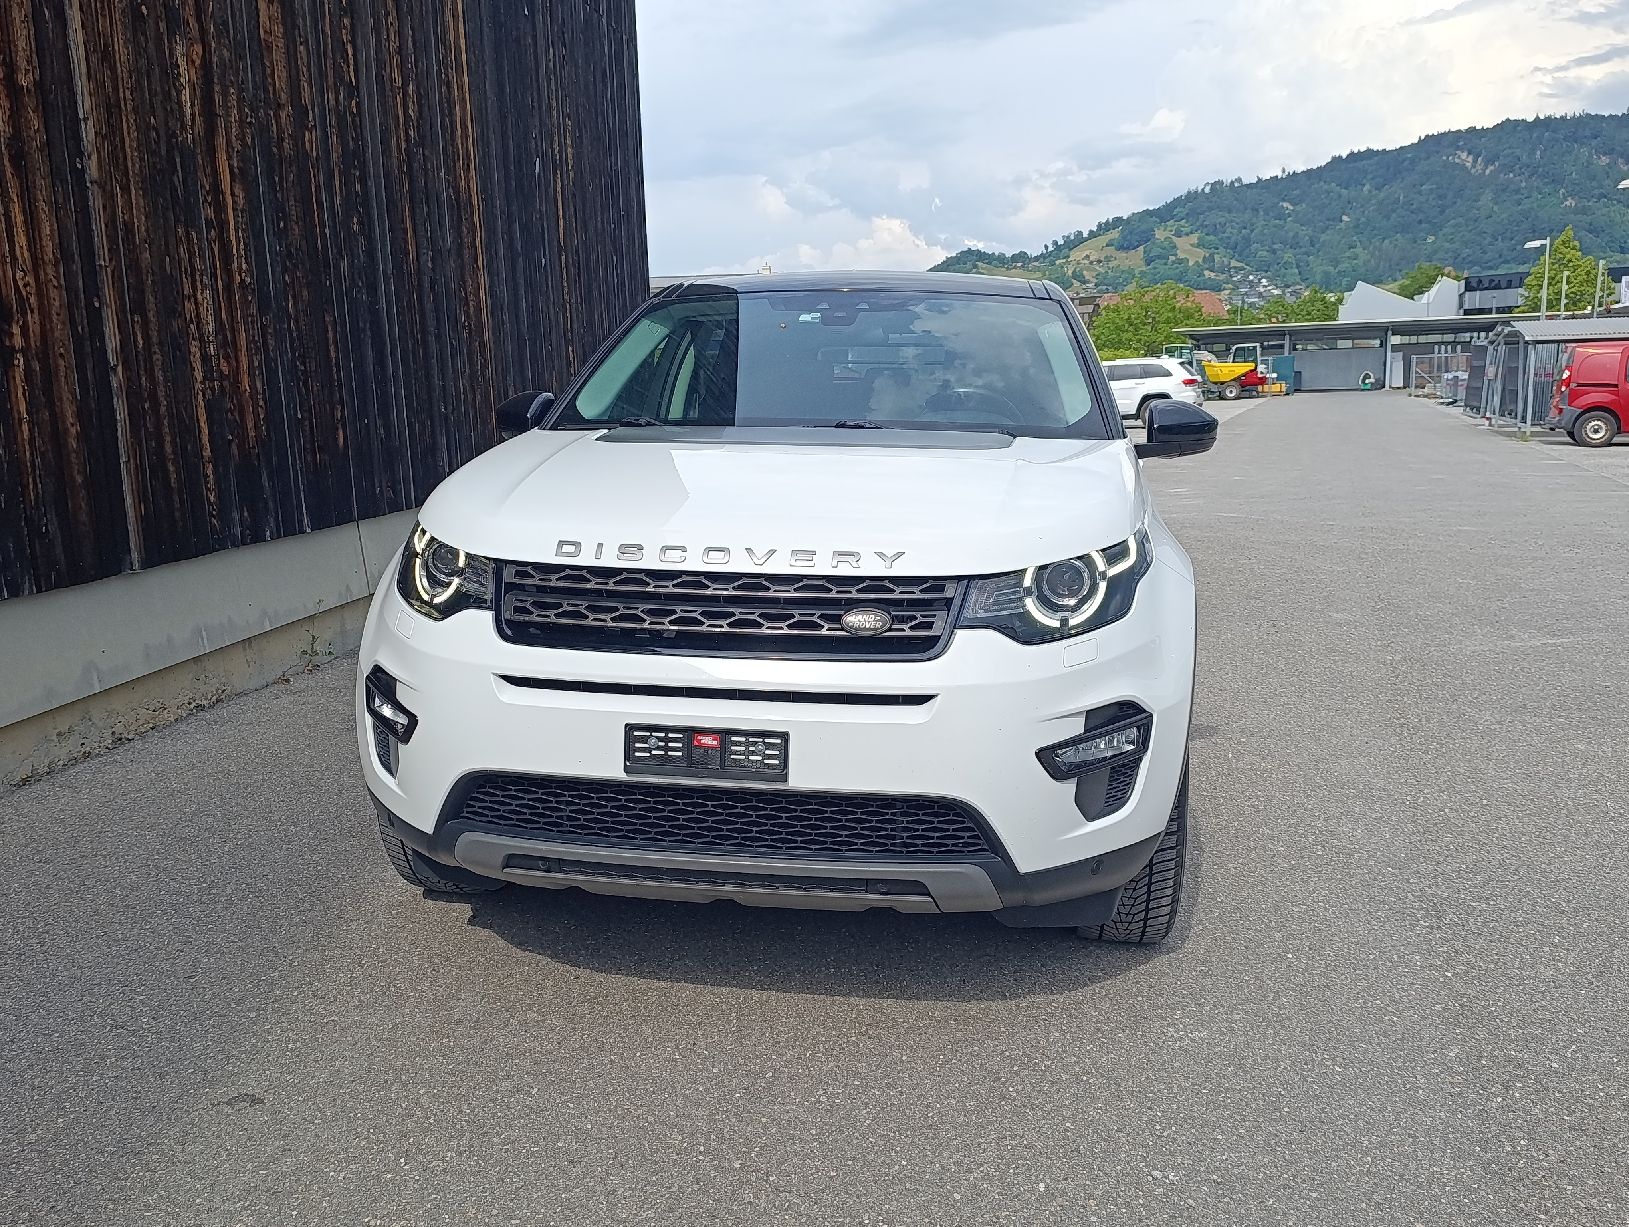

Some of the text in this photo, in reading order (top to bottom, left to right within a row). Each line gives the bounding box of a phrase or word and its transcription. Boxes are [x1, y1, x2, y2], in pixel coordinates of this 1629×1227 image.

[555, 540, 905, 569] DISCOVERY
[852, 614, 875, 622] LAND
[853, 621, 883, 629] ROVER
